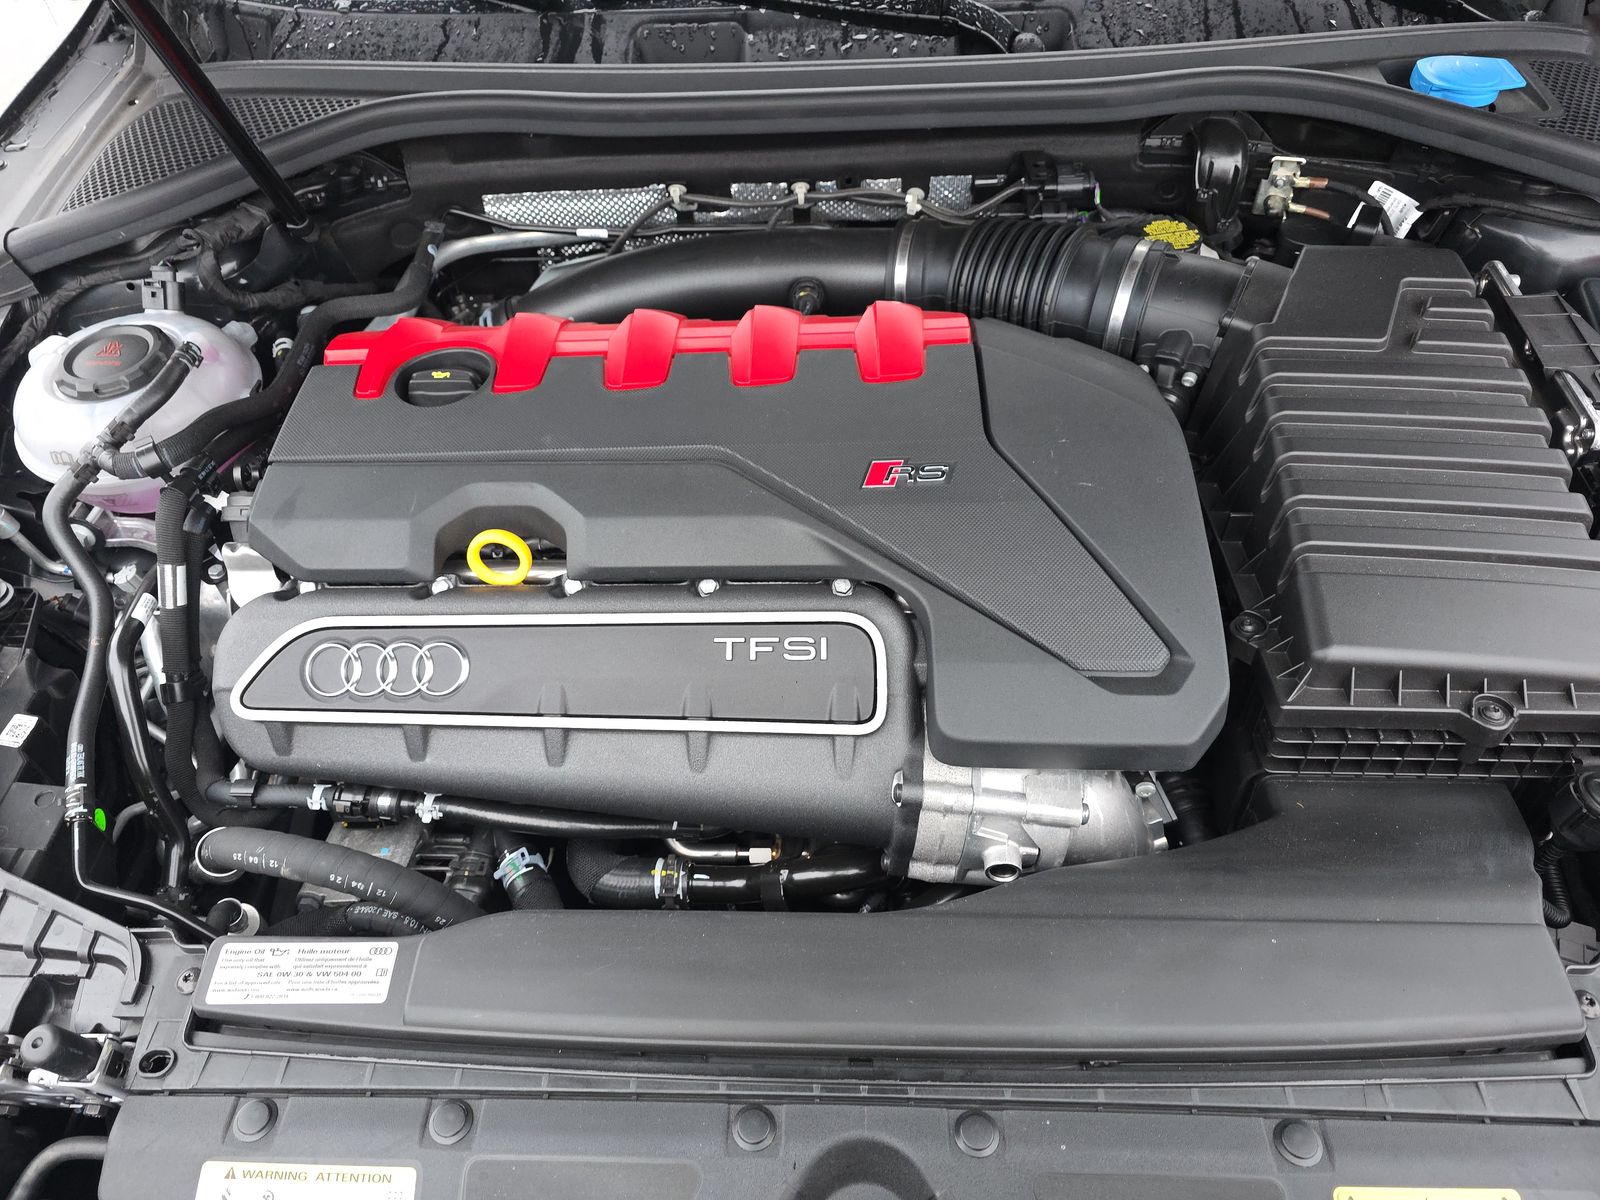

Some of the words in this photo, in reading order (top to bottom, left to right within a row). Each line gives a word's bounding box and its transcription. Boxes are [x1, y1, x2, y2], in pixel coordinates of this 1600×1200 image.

[882, 464, 949, 485] RS
[713, 636, 828, 661] TFSI
[269, 859, 279, 868] 12
[381, 909, 399, 919] SAE
[225, 948, 252, 956] Engine
[297, 947, 319, 955] Huile
[242, 1169, 308, 1182] WARNING
[315, 1172, 392, 1184] ATTENTION
